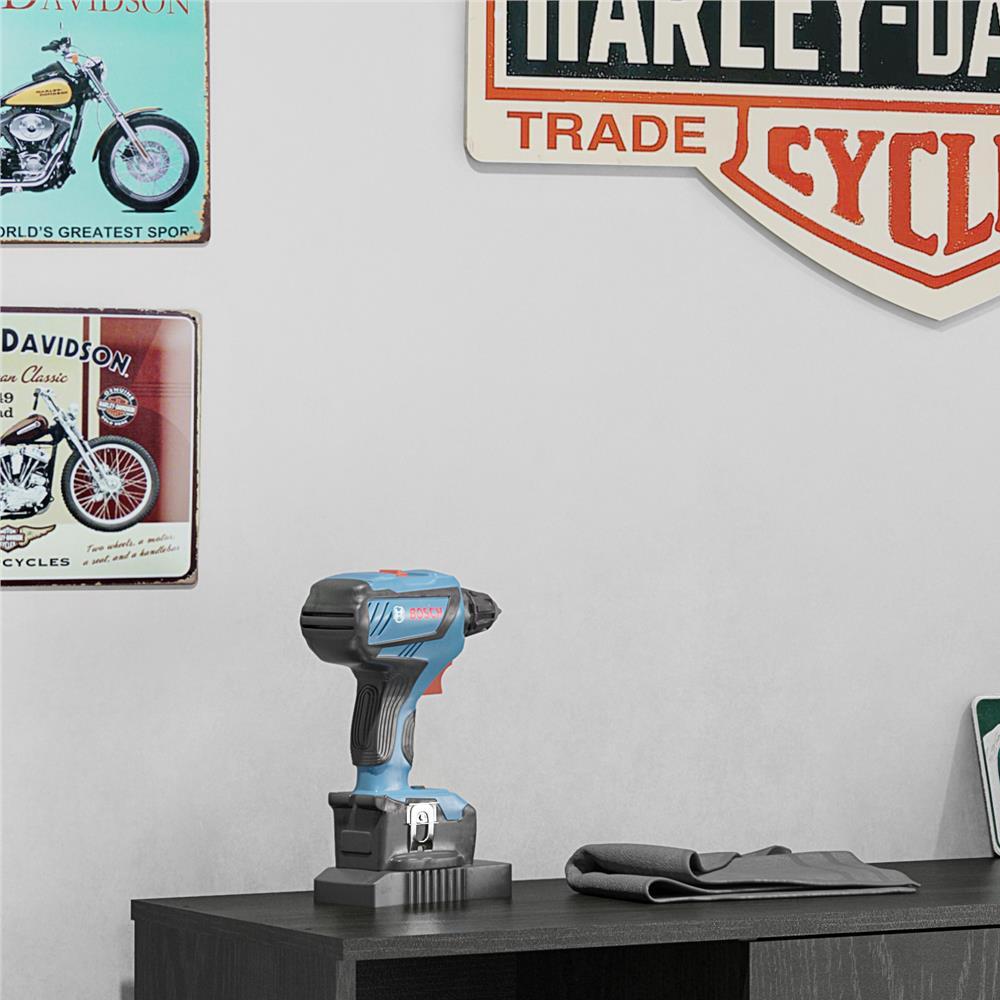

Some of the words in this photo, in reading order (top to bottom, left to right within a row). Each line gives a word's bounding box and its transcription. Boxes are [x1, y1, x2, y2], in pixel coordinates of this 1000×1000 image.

[506, 111, 707, 154] TRADE
[58, 226, 142, 238] GREATEST
[21, 365, 69, 384] Classic
[3, 558, 70, 567] CYCLES
[409, 607, 443, 620] BOSCH
